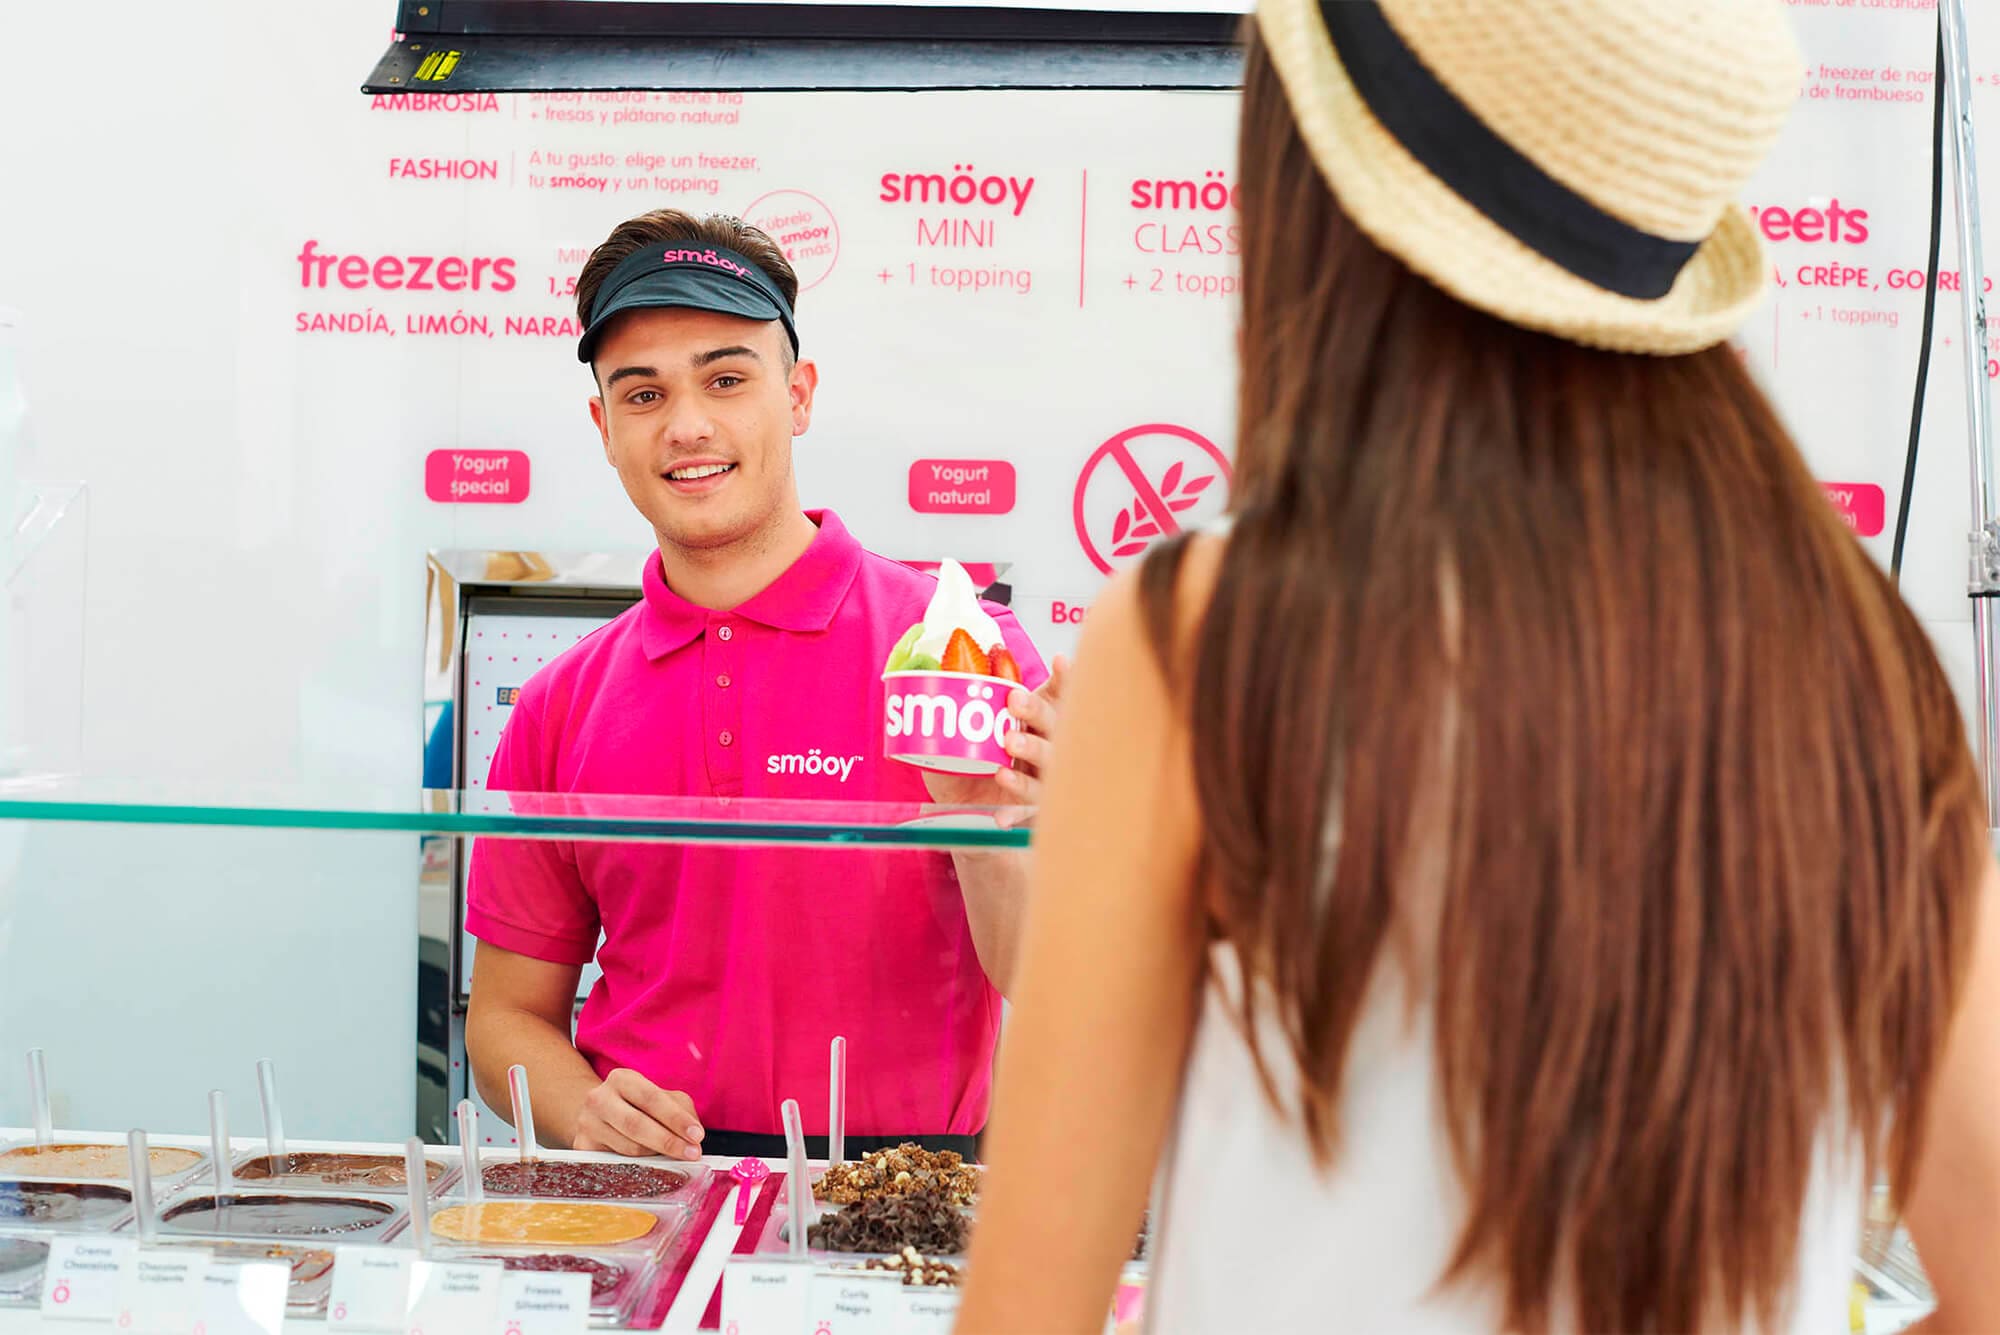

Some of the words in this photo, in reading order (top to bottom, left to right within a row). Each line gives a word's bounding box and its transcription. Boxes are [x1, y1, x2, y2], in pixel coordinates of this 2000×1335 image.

[1819, 64, 1875, 81] freezer
[1880, 67, 1900, 82] de
[371, 93, 499, 112] AMBROSIA
[1809, 84, 1830, 99] de
[1835, 83, 1924, 102] frambuesa
[545, 105, 595, 121] fresas
[600, 111, 609, 126] y
[613, 106, 677, 126] plátano
[680, 110, 739, 125] natural
[389, 158, 498, 179] FASHION
[529, 151, 542, 166] A
[547, 151, 562, 166] tu
[625, 153, 666, 172] elige
[671, 156, 692, 169] un
[529, 174, 544, 188] tu
[550, 173, 608, 192] smöoy
[612, 177, 621, 192] y
[627, 177, 648, 190] un
[654, 174, 720, 195] topping
[879, 163, 1035, 217] smöoy
[1750, 198, 1869, 244] eets
[917, 218, 995, 248] MINI
[297, 240, 517, 292] freezers
[906, 264, 916, 286] 1
[930, 264, 1032, 294] topping
[1149, 268, 1164, 292] 2
[295, 308, 397, 336] SANDÍA,
[406, 310, 494, 338] LIMÓN,
[1832, 307, 1899, 328] topping
[452, 454, 509, 475] Yogurt
[931, 465, 989, 485] Yogurt
[450, 478, 510, 497] special
[928, 488, 990, 505] natural
